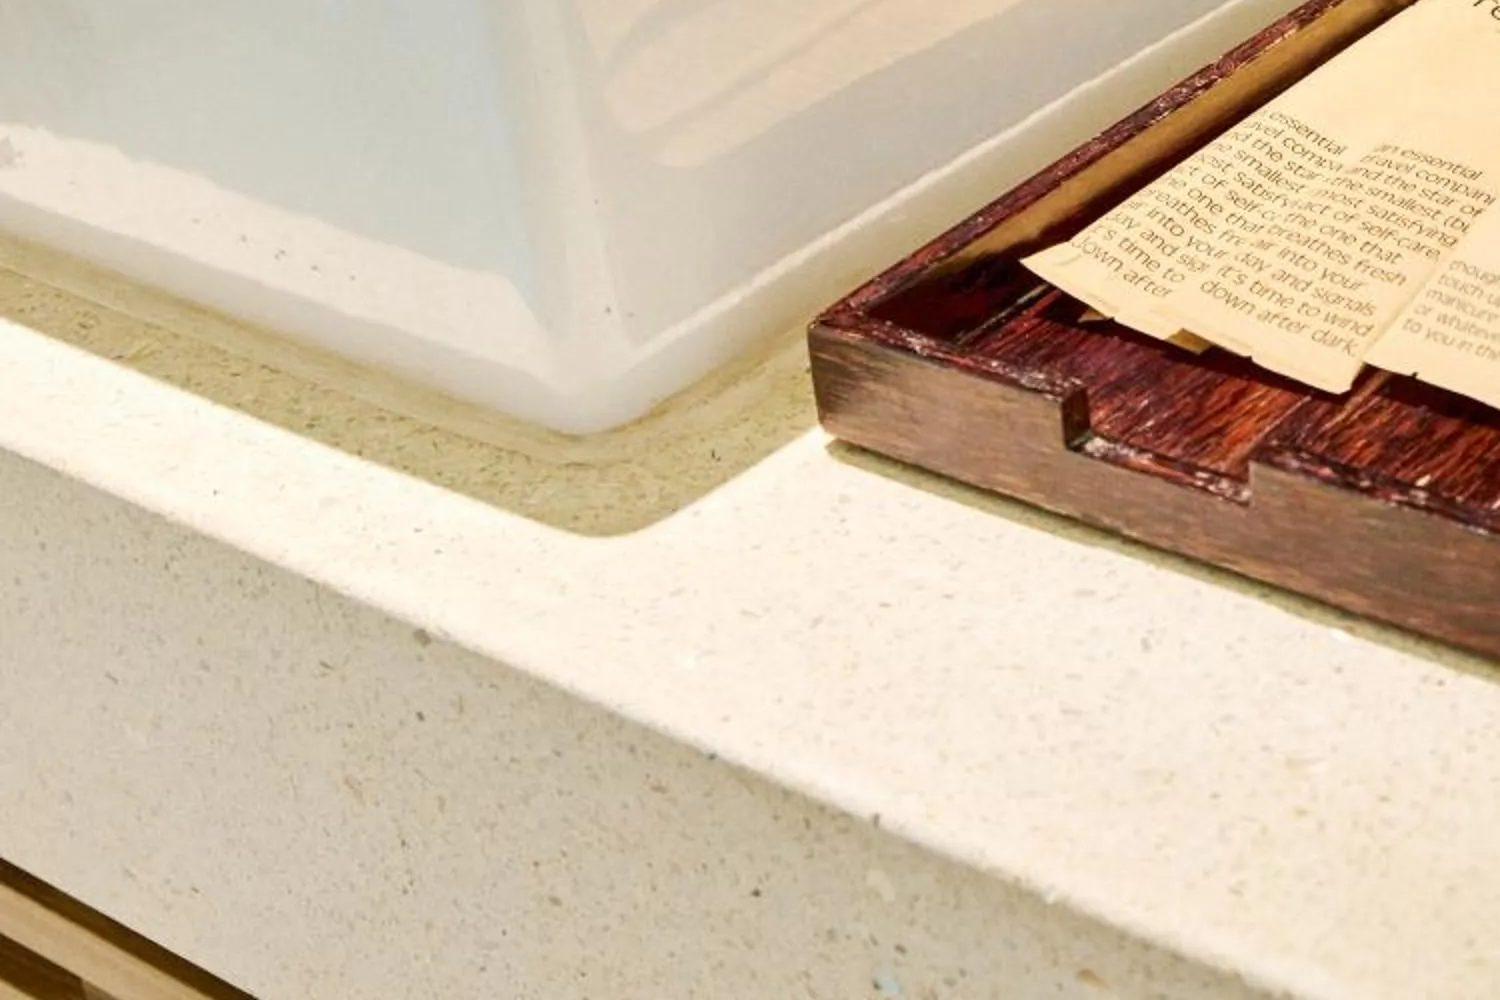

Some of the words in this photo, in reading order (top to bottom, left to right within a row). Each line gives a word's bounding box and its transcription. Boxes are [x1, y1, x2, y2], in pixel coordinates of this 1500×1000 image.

[1252, 139, 1283, 163] the
[1400, 148, 1483, 181] essential
[1201, 174, 1228, 188] of
[1233, 149, 1306, 194] smallest
[1188, 188, 1223, 214] one
[1364, 187, 1441, 220] smallest
[1384, 174, 1417, 191] the
[1418, 187, 1454, 206] star
[1460, 204, 1486, 218] of
[1146, 207, 1185, 237] into
[1186, 235, 1228, 259] your
[1333, 211, 1361, 223] of
[1366, 204, 1458, 248] satisfying
[1118, 237, 1161, 273] time
[1162, 268, 1186, 283] to
[1140, 229, 1179, 256] and
[1320, 225, 1357, 245] one
[1360, 241, 1404, 265] that
[1122, 270, 1173, 298] after
[1234, 252, 1272, 273] day
[1271, 269, 1313, 293] and
[1311, 286, 1376, 317] signals
[1278, 246, 1318, 272] into
[1320, 267, 1367, 290] your
[1354, 259, 1406, 287] fresh
[1437, 274, 1485, 299] touch
[1200, 279, 1257, 315] down
[1257, 309, 1309, 334] after
[1249, 279, 1295, 309] time
[1297, 301, 1321, 317] to
[1324, 311, 1375, 337] wind
[1413, 303, 1434, 317] or
[1425, 288, 1500, 323] manicure
[1402, 317, 1423, 334] to
[1424, 327, 1457, 347] you
[1457, 339, 1473, 353] in
